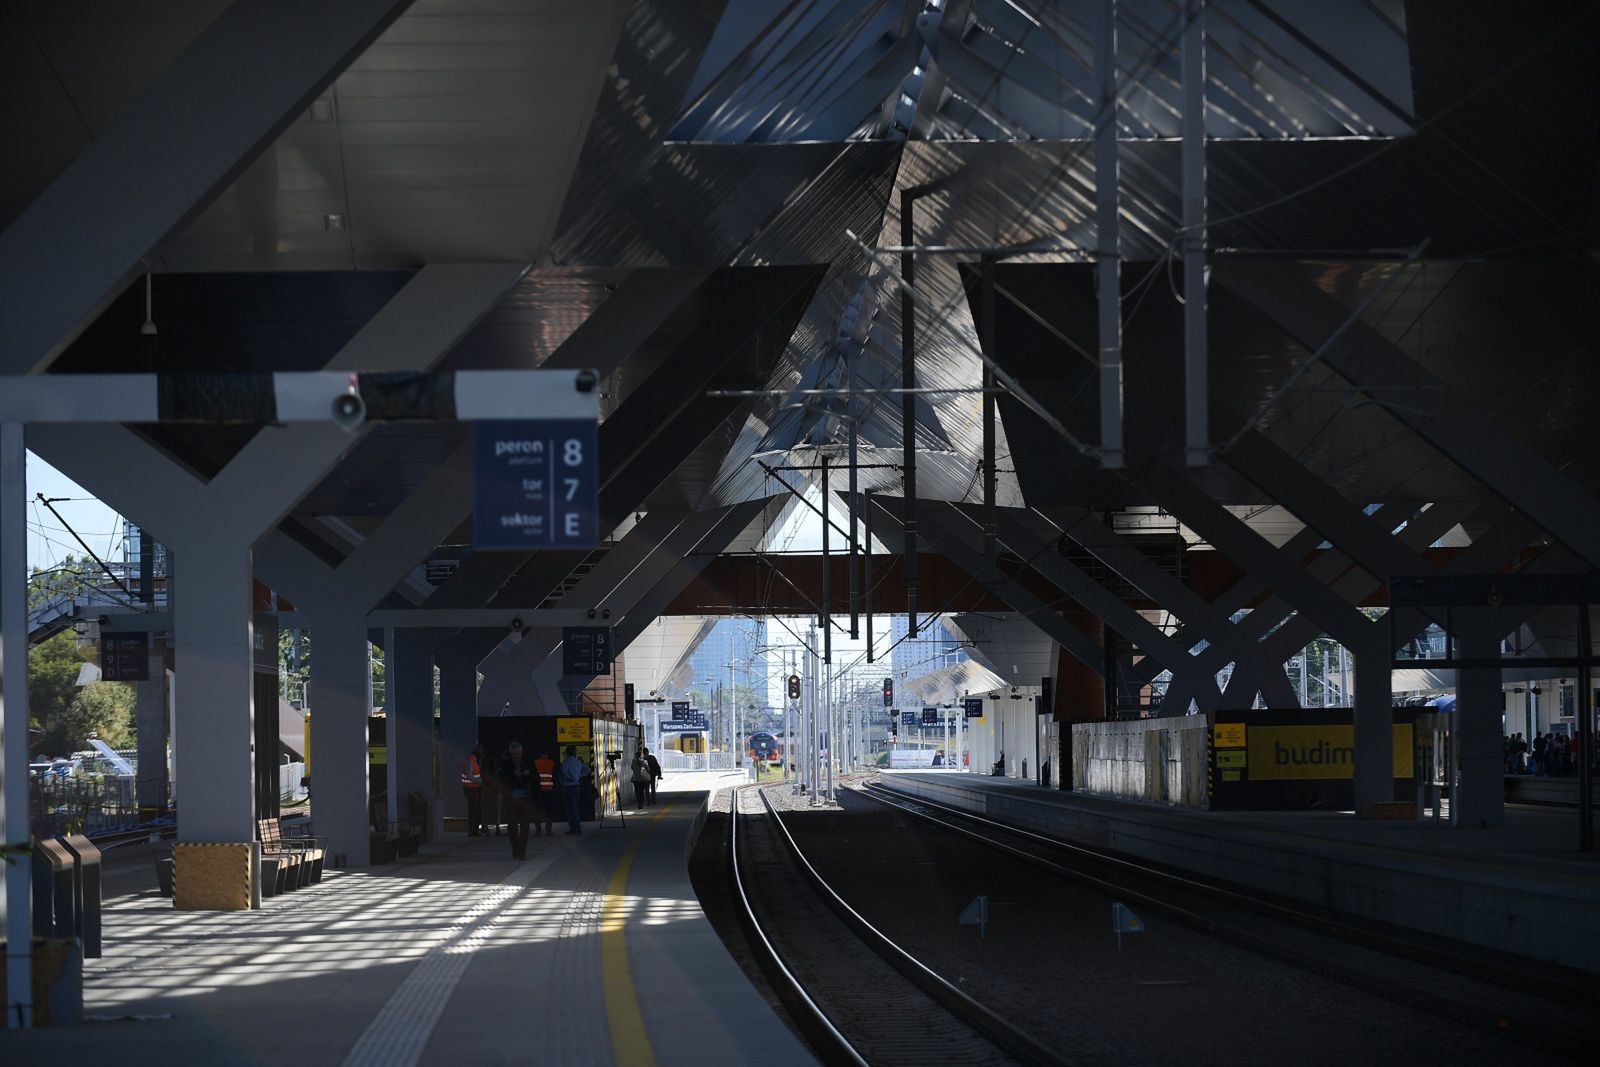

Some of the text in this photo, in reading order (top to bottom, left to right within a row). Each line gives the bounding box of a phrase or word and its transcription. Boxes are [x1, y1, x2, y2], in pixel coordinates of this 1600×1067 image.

[496, 439, 583, 466] peron 8
[522, 478, 544, 491] tor
[563, 478, 581, 502] 7
[500, 512, 581, 537] sektor E
[597, 634, 605, 644] 8
[107, 641, 113, 651] 8
[596, 648, 604, 658] 7
[107, 655, 114, 664] 9
[596, 661, 605, 671] D
[1275, 740, 1355, 765] budim
